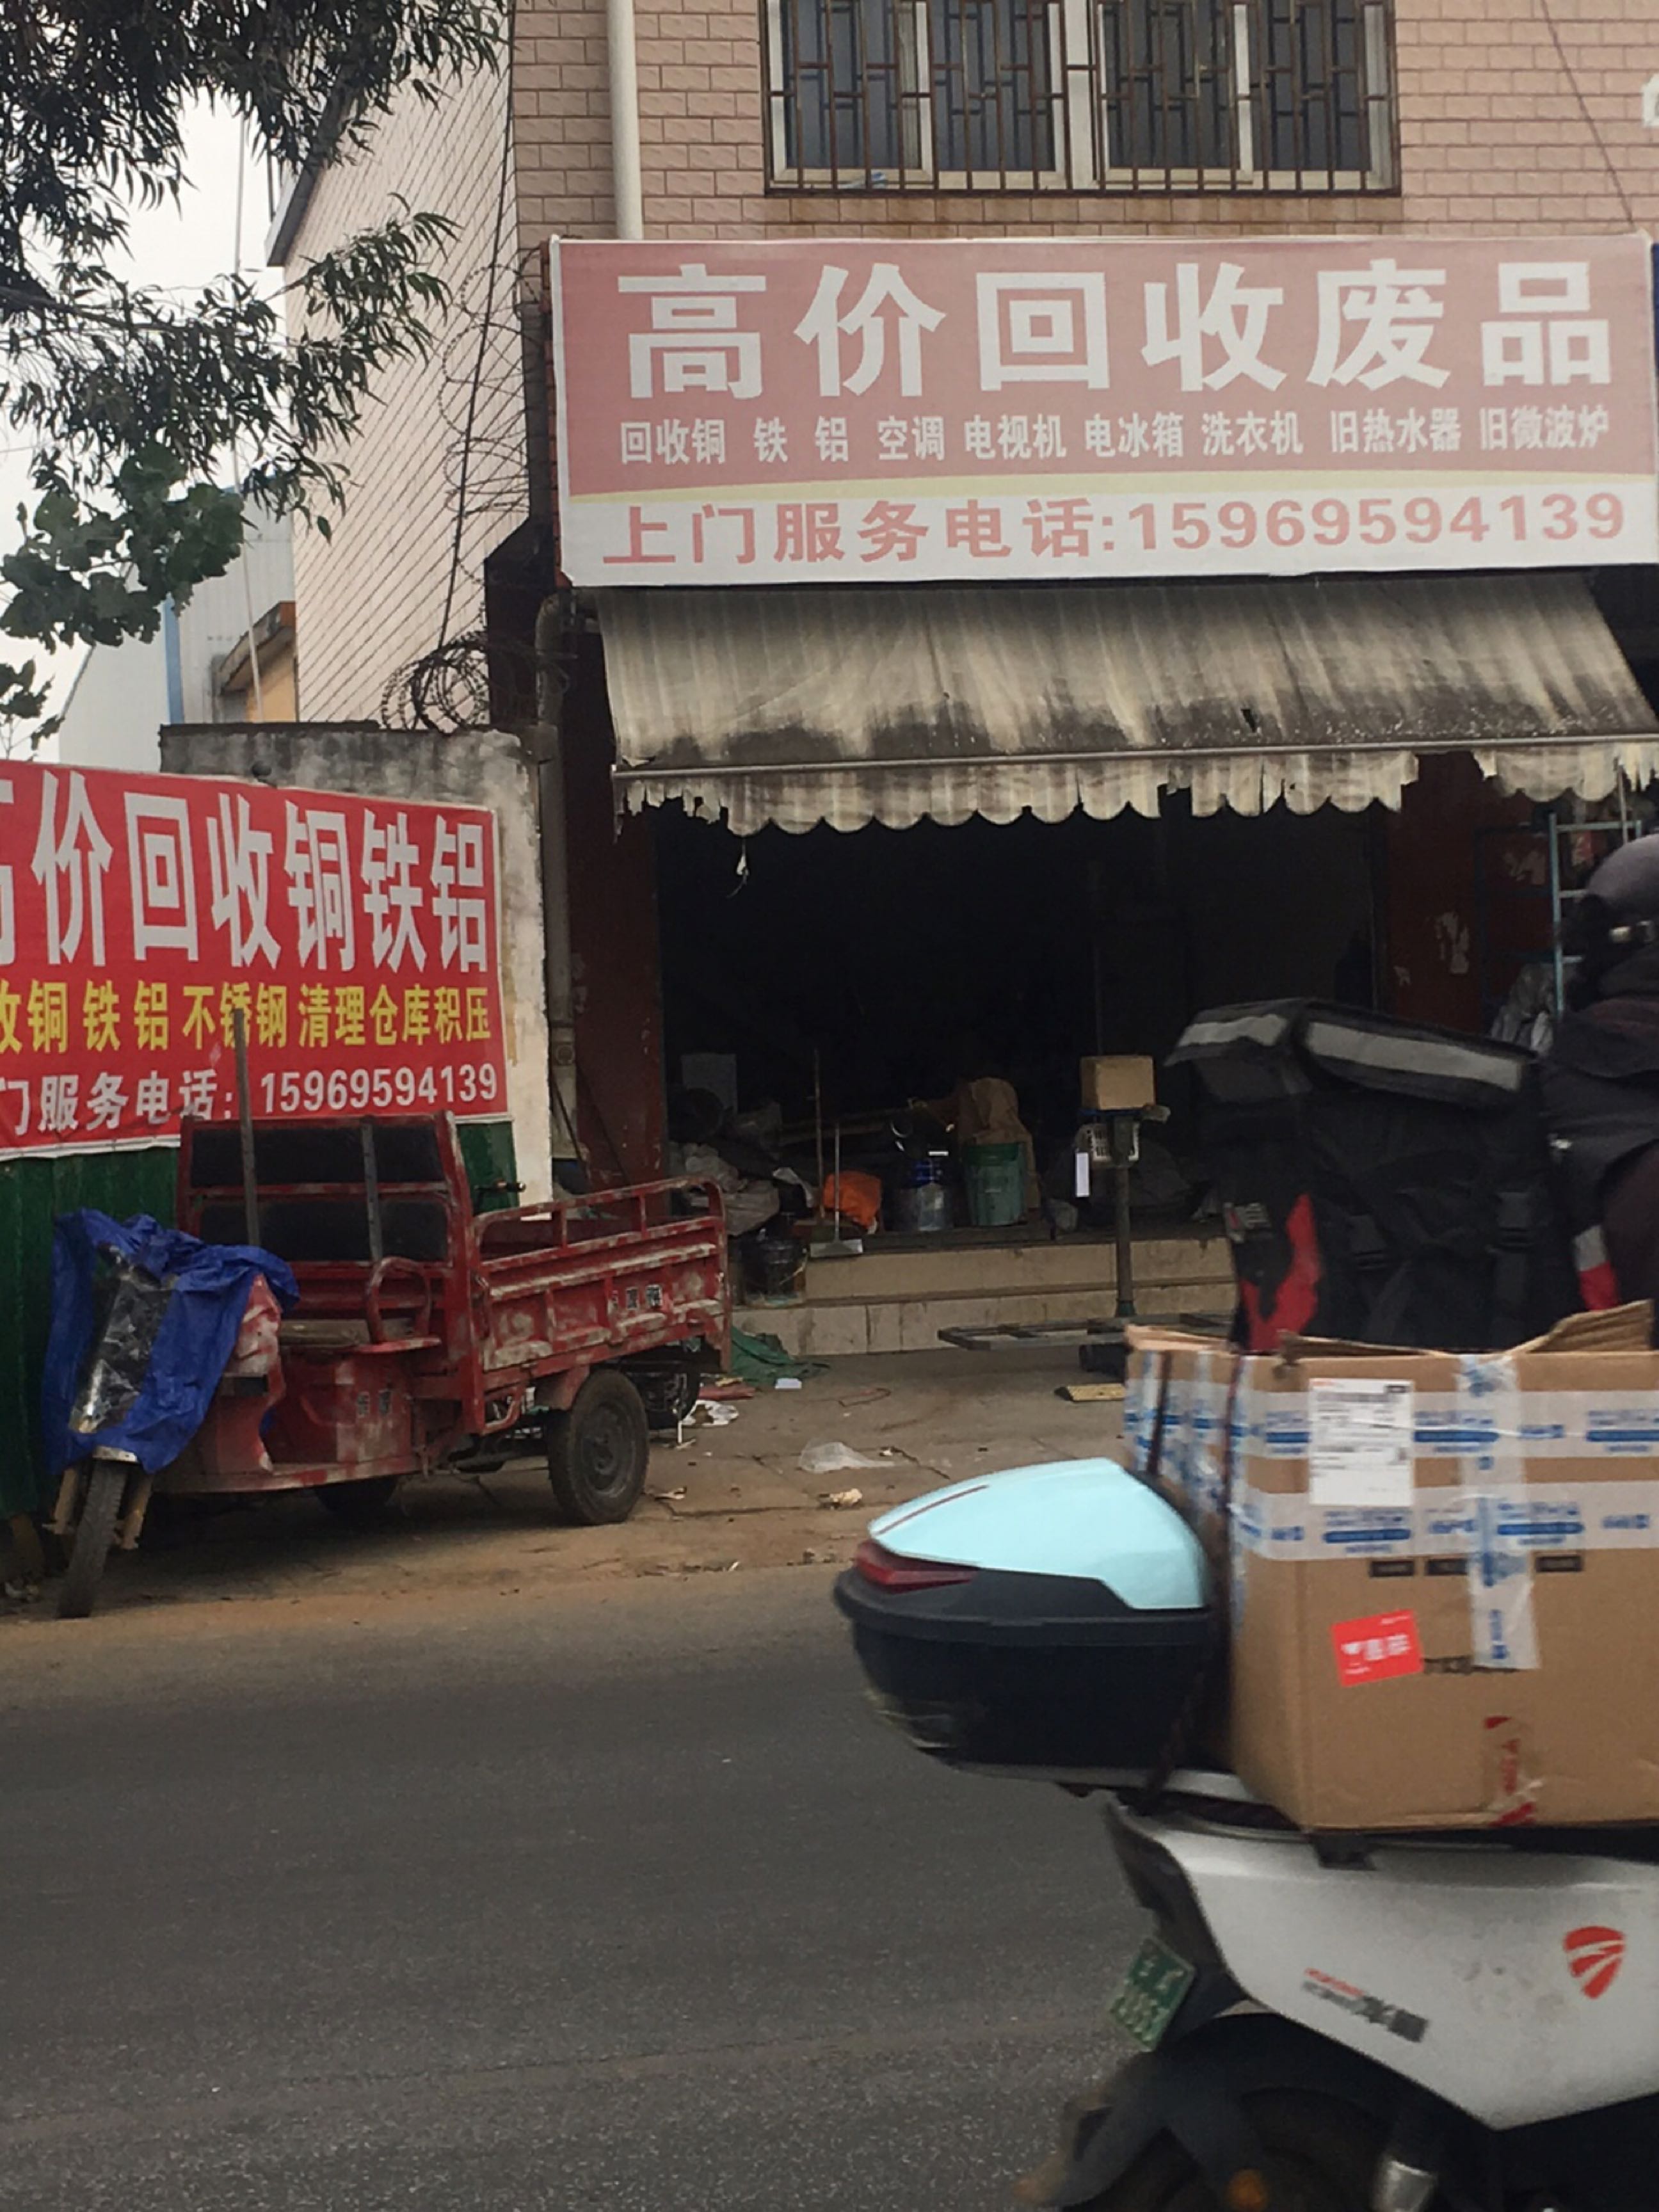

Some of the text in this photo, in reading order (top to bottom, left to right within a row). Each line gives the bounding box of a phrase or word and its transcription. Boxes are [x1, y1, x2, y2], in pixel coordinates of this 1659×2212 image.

[618, 259, 1611, 399] 高价回收废品
[621, 405, 1609, 465] 回收铜 铁 铝 空调 电视机 电冰箱 洗衣机 旧热水器 旧微波炉
[603, 492, 1624, 564] 上门服务电话:15969594139
[0, 769, 488, 973] 价回收铜铁铝
[83, 978, 121, 1052] 铁
[133, 979, 168, 1052] 铝
[182, 981, 287, 1051] 不锈钢
[298, 982, 492, 1048] 清理仓库积压
[260, 1062, 498, 1114] 15969594139
